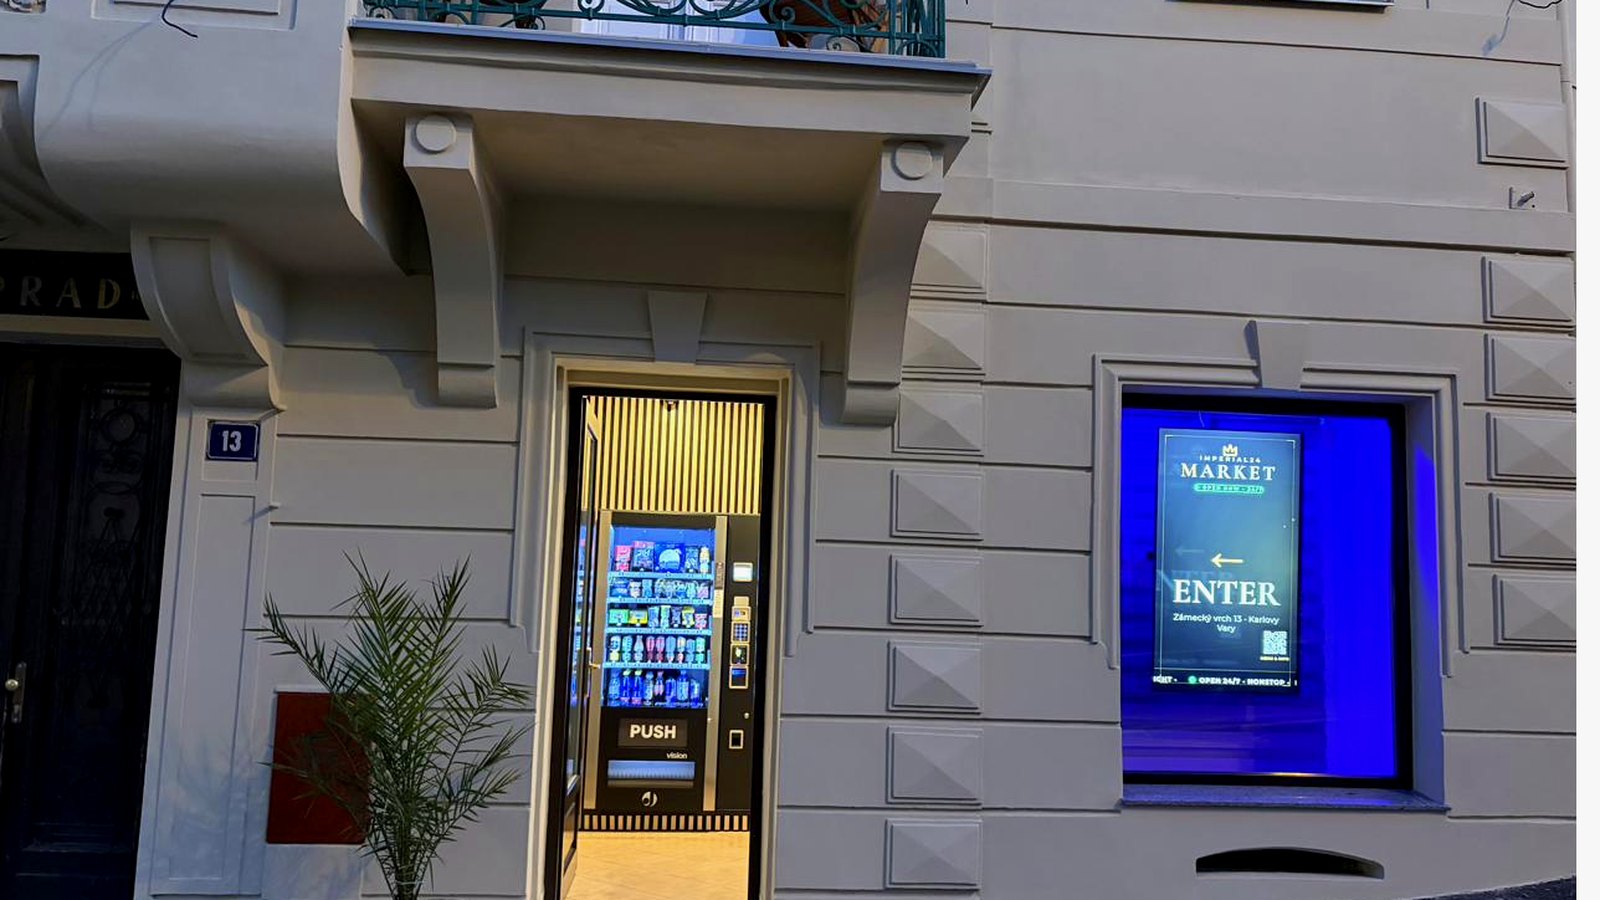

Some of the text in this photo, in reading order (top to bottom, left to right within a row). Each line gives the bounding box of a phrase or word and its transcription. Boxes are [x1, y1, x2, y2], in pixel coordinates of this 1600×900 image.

[222, 430, 242, 452] 13
[1199, 455, 1261, 463] IMPERIAL24
[1180, 463, 1276, 480] MARKET
[1172, 579, 1281, 606] ENTER
[1213, 615, 1232, 623] vrch
[1234, 615, 1242, 623] 13
[1248, 616, 1280, 625] Karlovy
[629, 724, 677, 739] PUSH
[666, 752, 688, 760] vision
